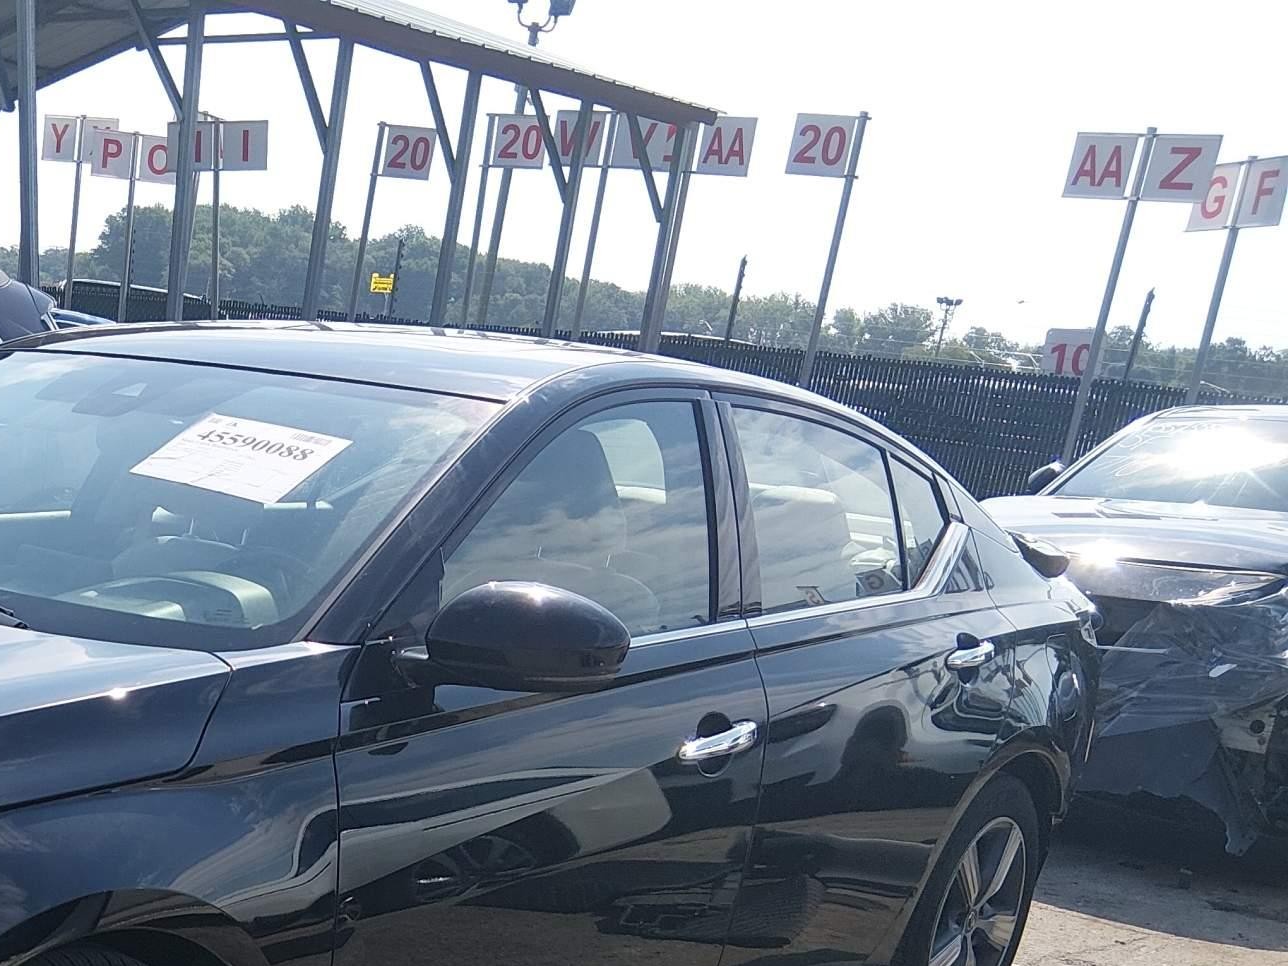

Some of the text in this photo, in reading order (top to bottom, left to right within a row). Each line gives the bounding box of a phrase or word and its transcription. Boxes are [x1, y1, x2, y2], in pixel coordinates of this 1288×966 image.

[52, 123, 70, 154] Y
[101, 138, 123, 169] P
[242, 129, 249, 162] I
[388, 134, 429, 170] 20
[498, 123, 543, 160] 20
[703, 127, 744, 165] AA
[793, 125, 846, 165] 20
[1071, 145, 1122, 187] AA
[1159, 147, 1202, 190] Z
[1200, 176, 1227, 219] G
[1251, 170, 1280, 215] F
[198, 429, 314, 461] 45590088
